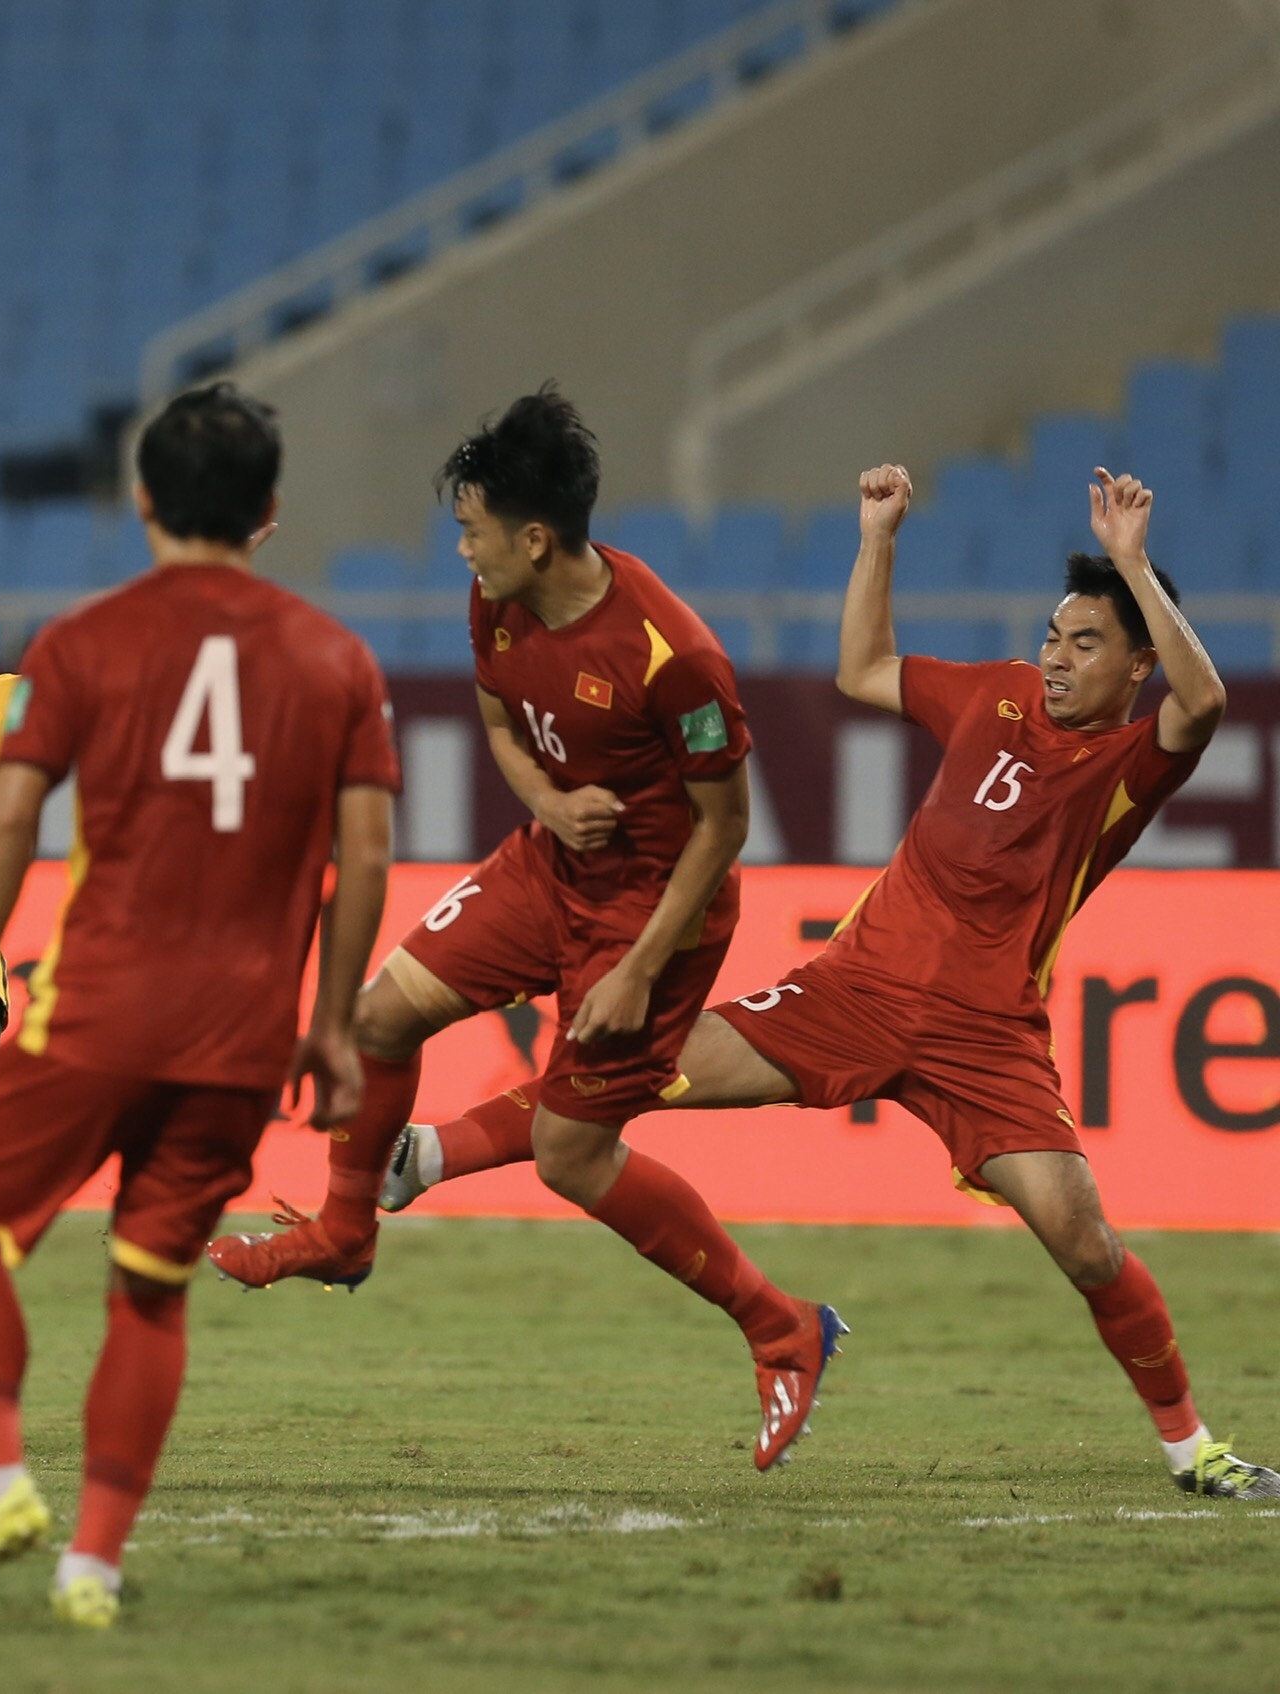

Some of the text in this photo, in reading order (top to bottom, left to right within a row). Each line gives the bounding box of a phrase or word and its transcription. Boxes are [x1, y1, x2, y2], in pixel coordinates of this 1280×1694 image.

[162, 635, 255, 833] 4
[522, 699, 567, 763] 16
[973, 750, 1034, 811] 15
